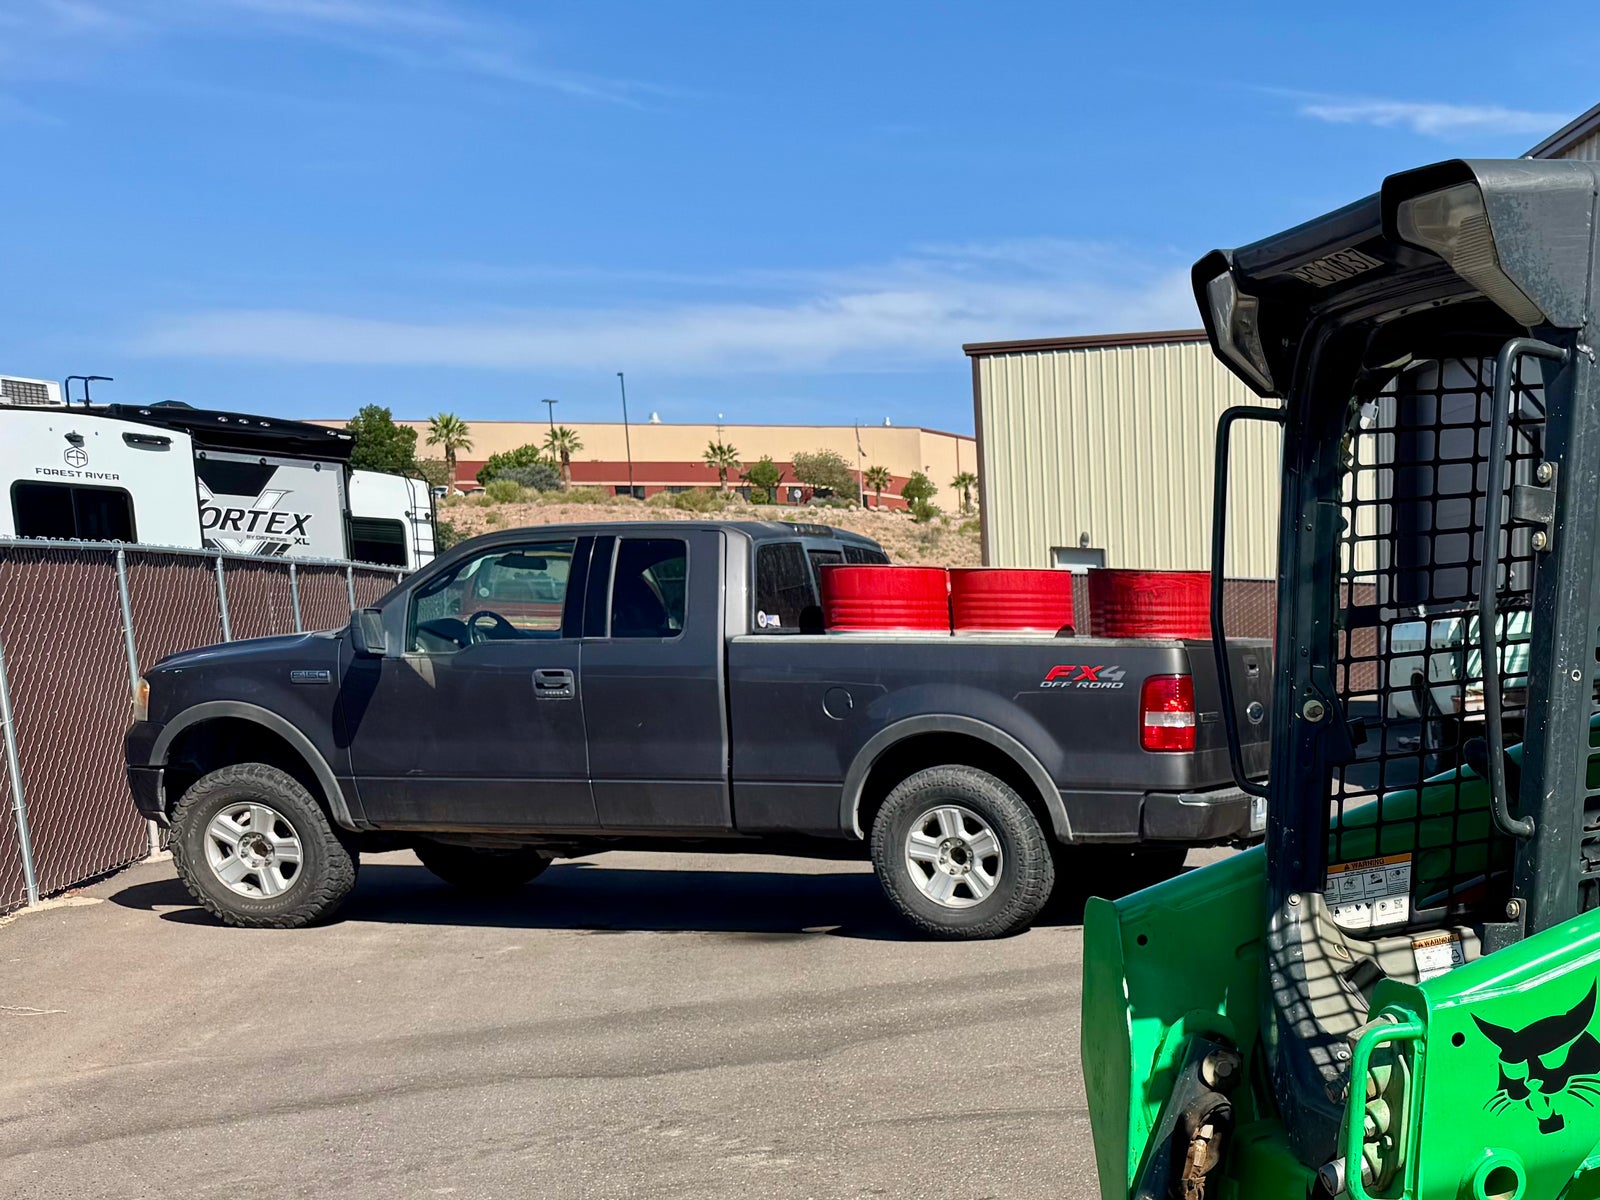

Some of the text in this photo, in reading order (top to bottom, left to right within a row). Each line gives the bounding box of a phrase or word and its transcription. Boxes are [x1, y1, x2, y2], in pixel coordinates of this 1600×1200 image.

[35, 467, 120, 481] FOREST RIVER
[294, 537, 311, 546] XL
[1044, 664, 1127, 682] FX4
[1076, 681, 1124, 689] ROAD
[1351, 858, 1385, 871] WARNING
[1423, 934, 1455, 948] WARNING
